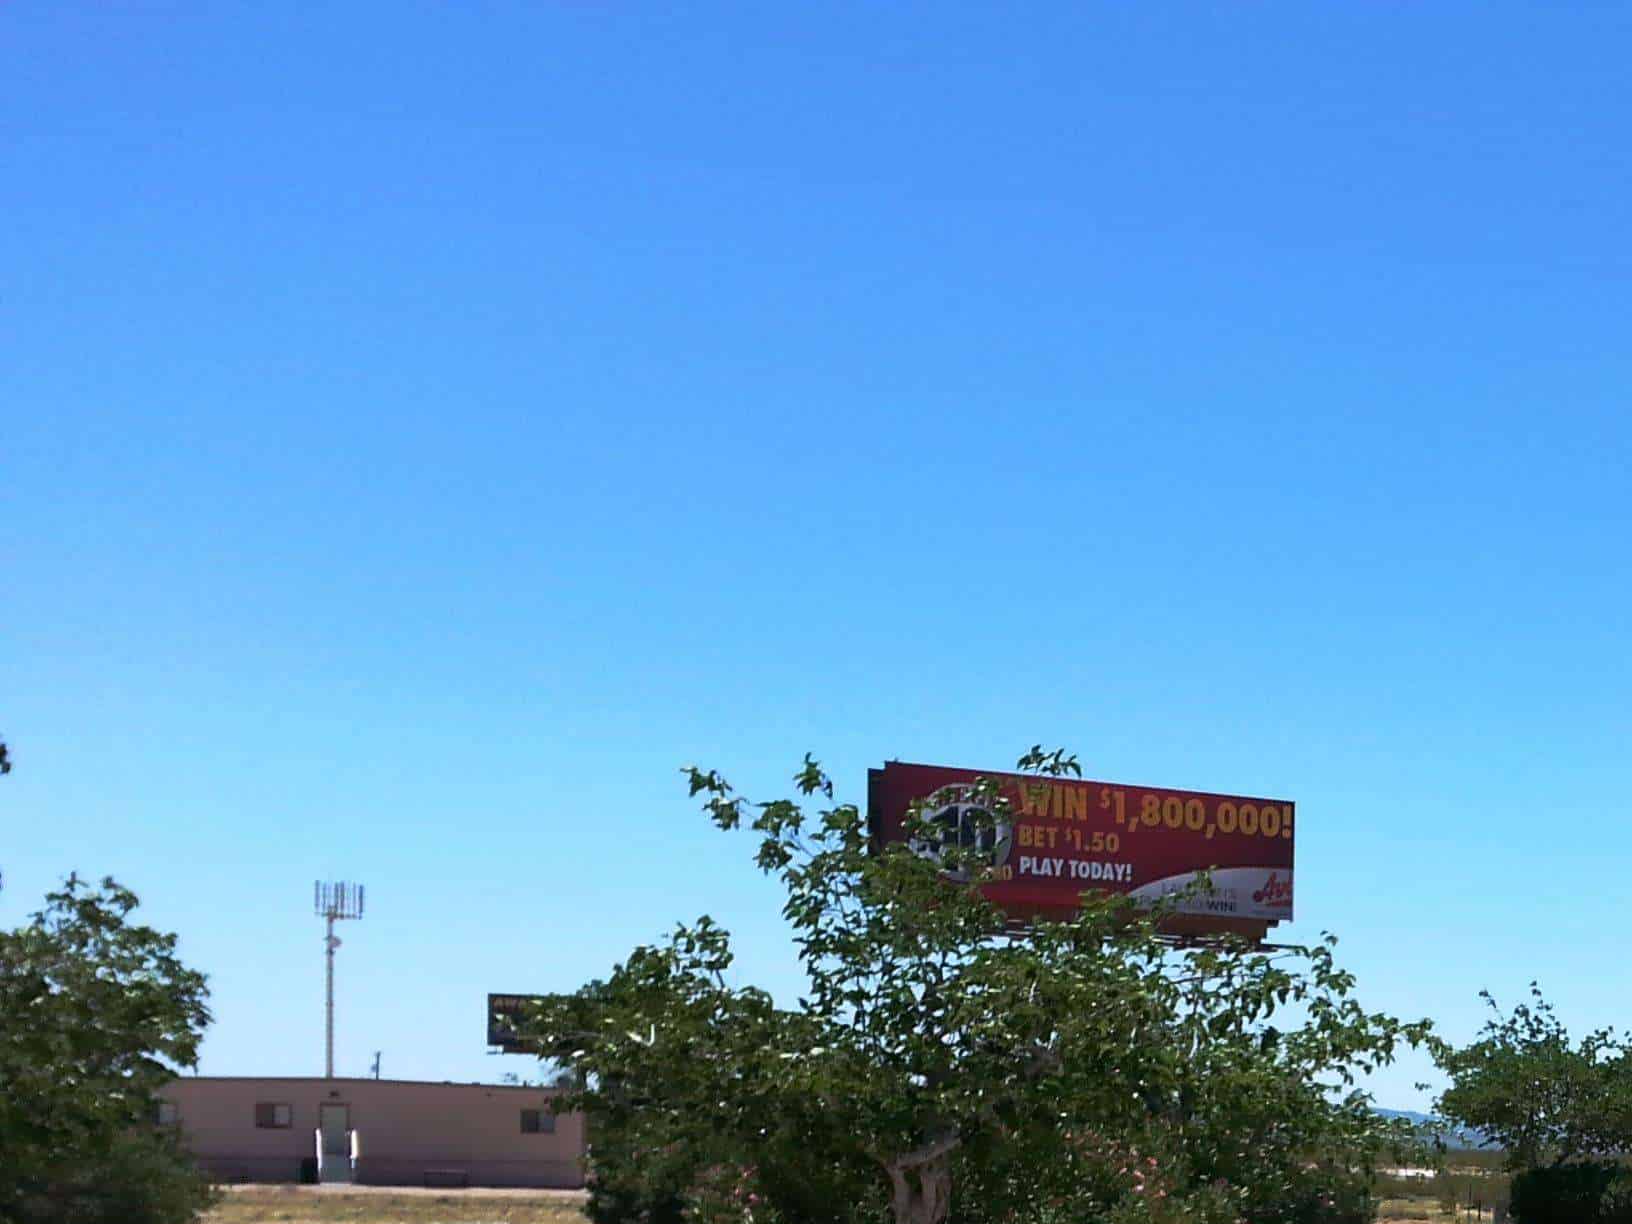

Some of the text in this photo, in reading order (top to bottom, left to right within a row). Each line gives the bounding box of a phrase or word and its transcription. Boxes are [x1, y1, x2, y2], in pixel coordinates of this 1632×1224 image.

[1019, 784, 1292, 840] WIN $1,800,000!
[1019, 825, 1119, 852] BET $1.50
[1019, 856, 1064, 877] PLAY
[1069, 860, 1132, 881] TODAY!
